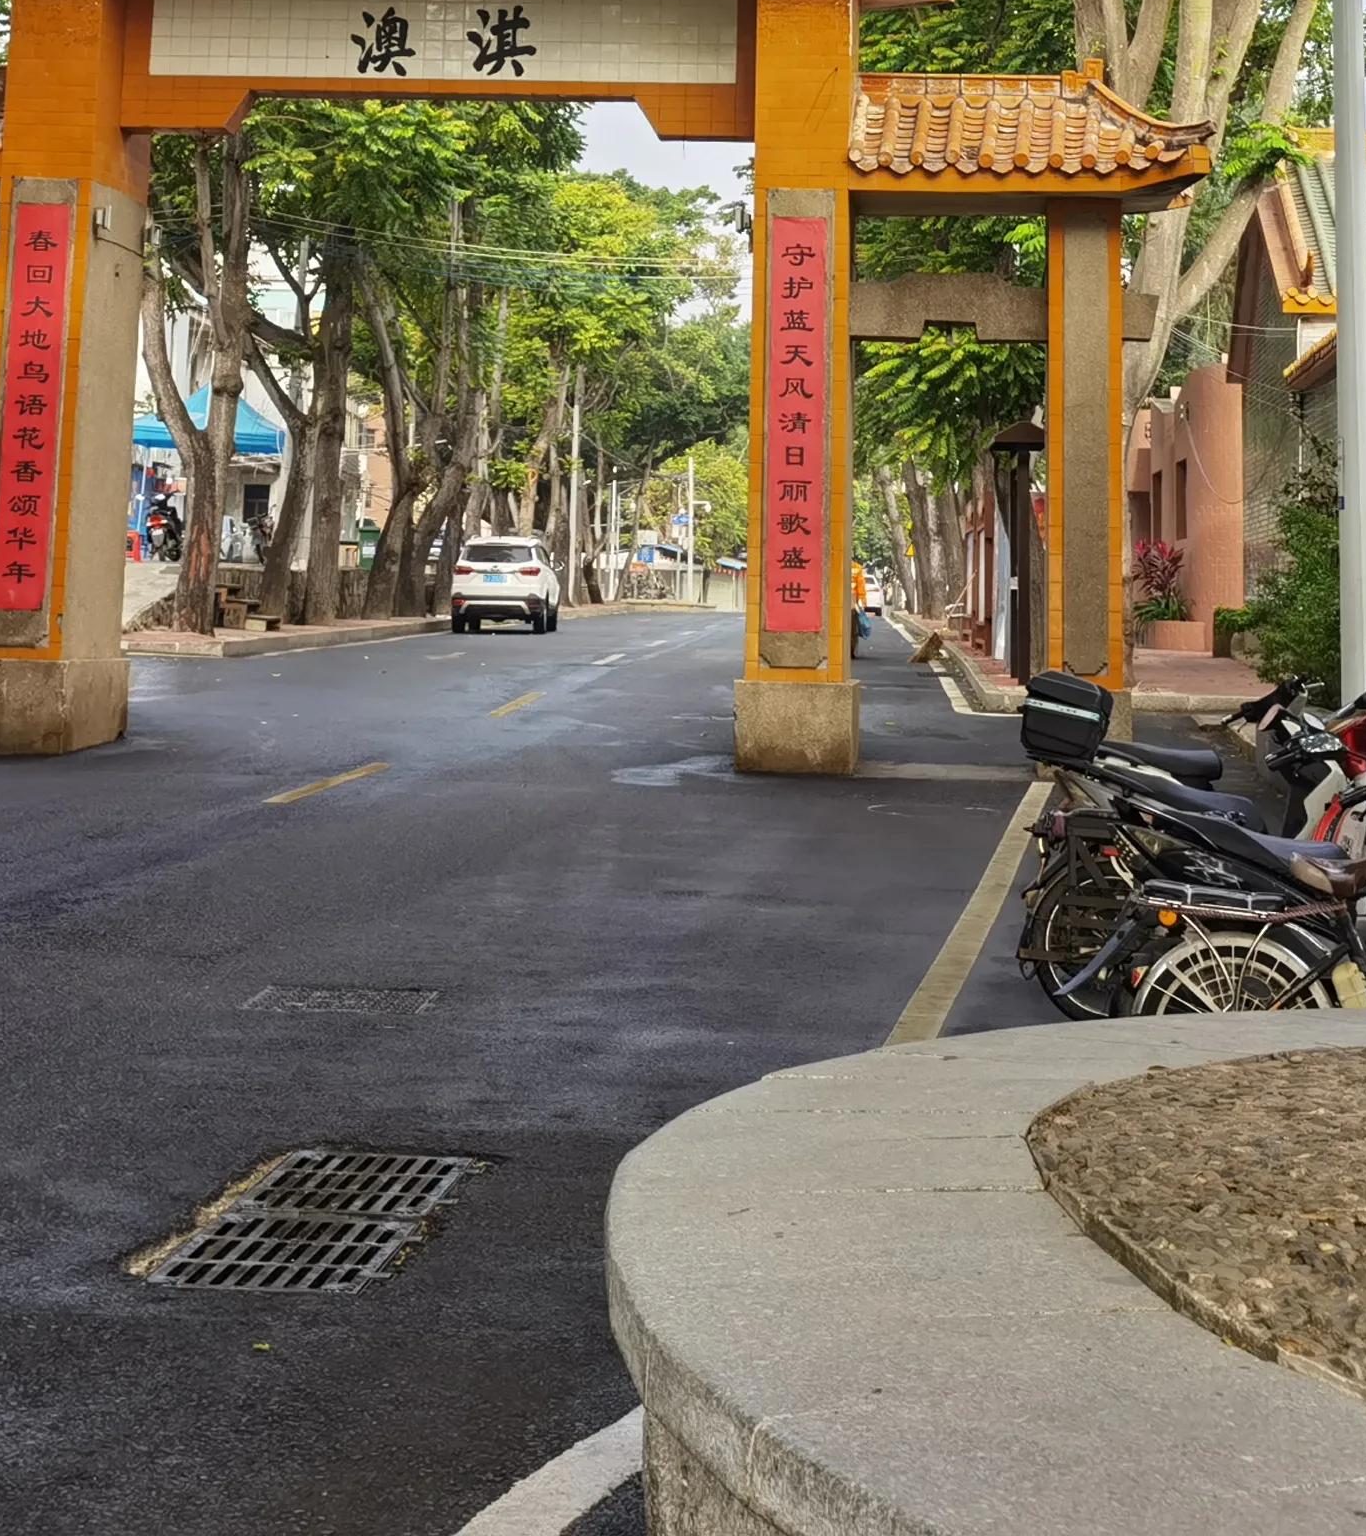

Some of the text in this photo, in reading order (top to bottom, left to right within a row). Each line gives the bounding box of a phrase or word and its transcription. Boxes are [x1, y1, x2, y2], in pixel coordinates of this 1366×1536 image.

[2, 230, 58, 584] 春回大地鸟语花香颂华年
[775, 243, 816, 604] 守护蓝天风清日丽歌盛世
